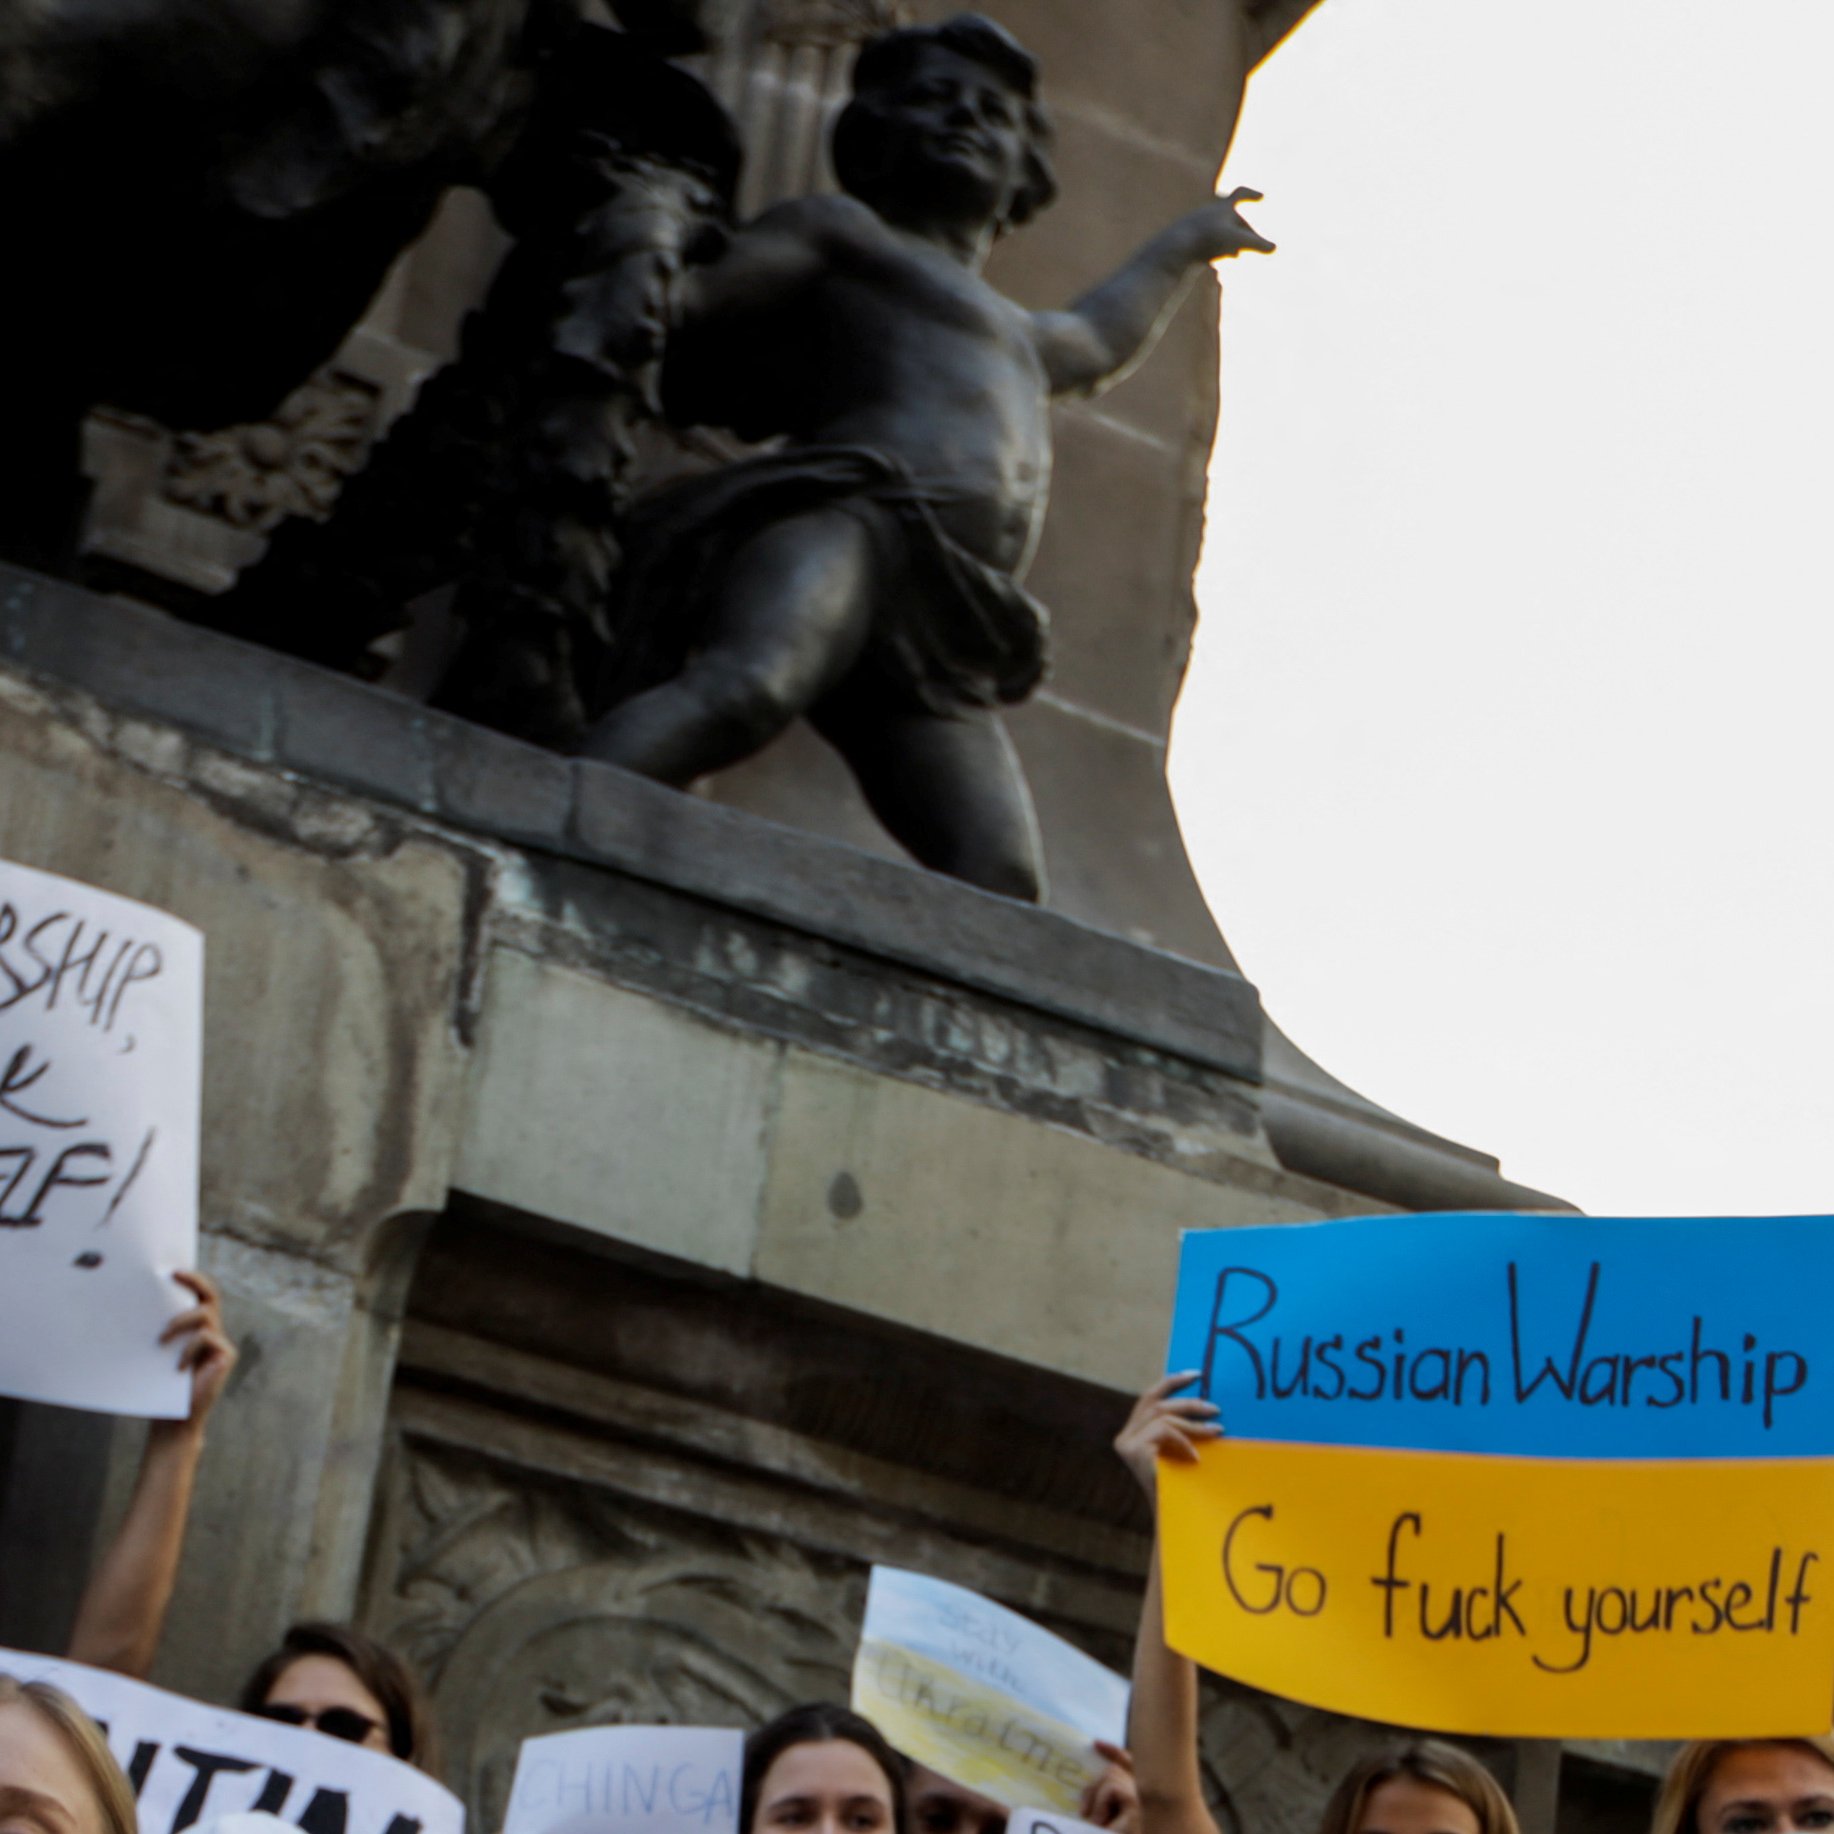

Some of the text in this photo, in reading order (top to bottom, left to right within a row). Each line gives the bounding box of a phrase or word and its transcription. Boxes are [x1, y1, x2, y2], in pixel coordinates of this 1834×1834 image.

[1199, 1261, 1808, 1430] Russian Warship
[1221, 1504, 1821, 1675] Go fuck yourself
[518, 1758, 735, 1824] CHINGA
